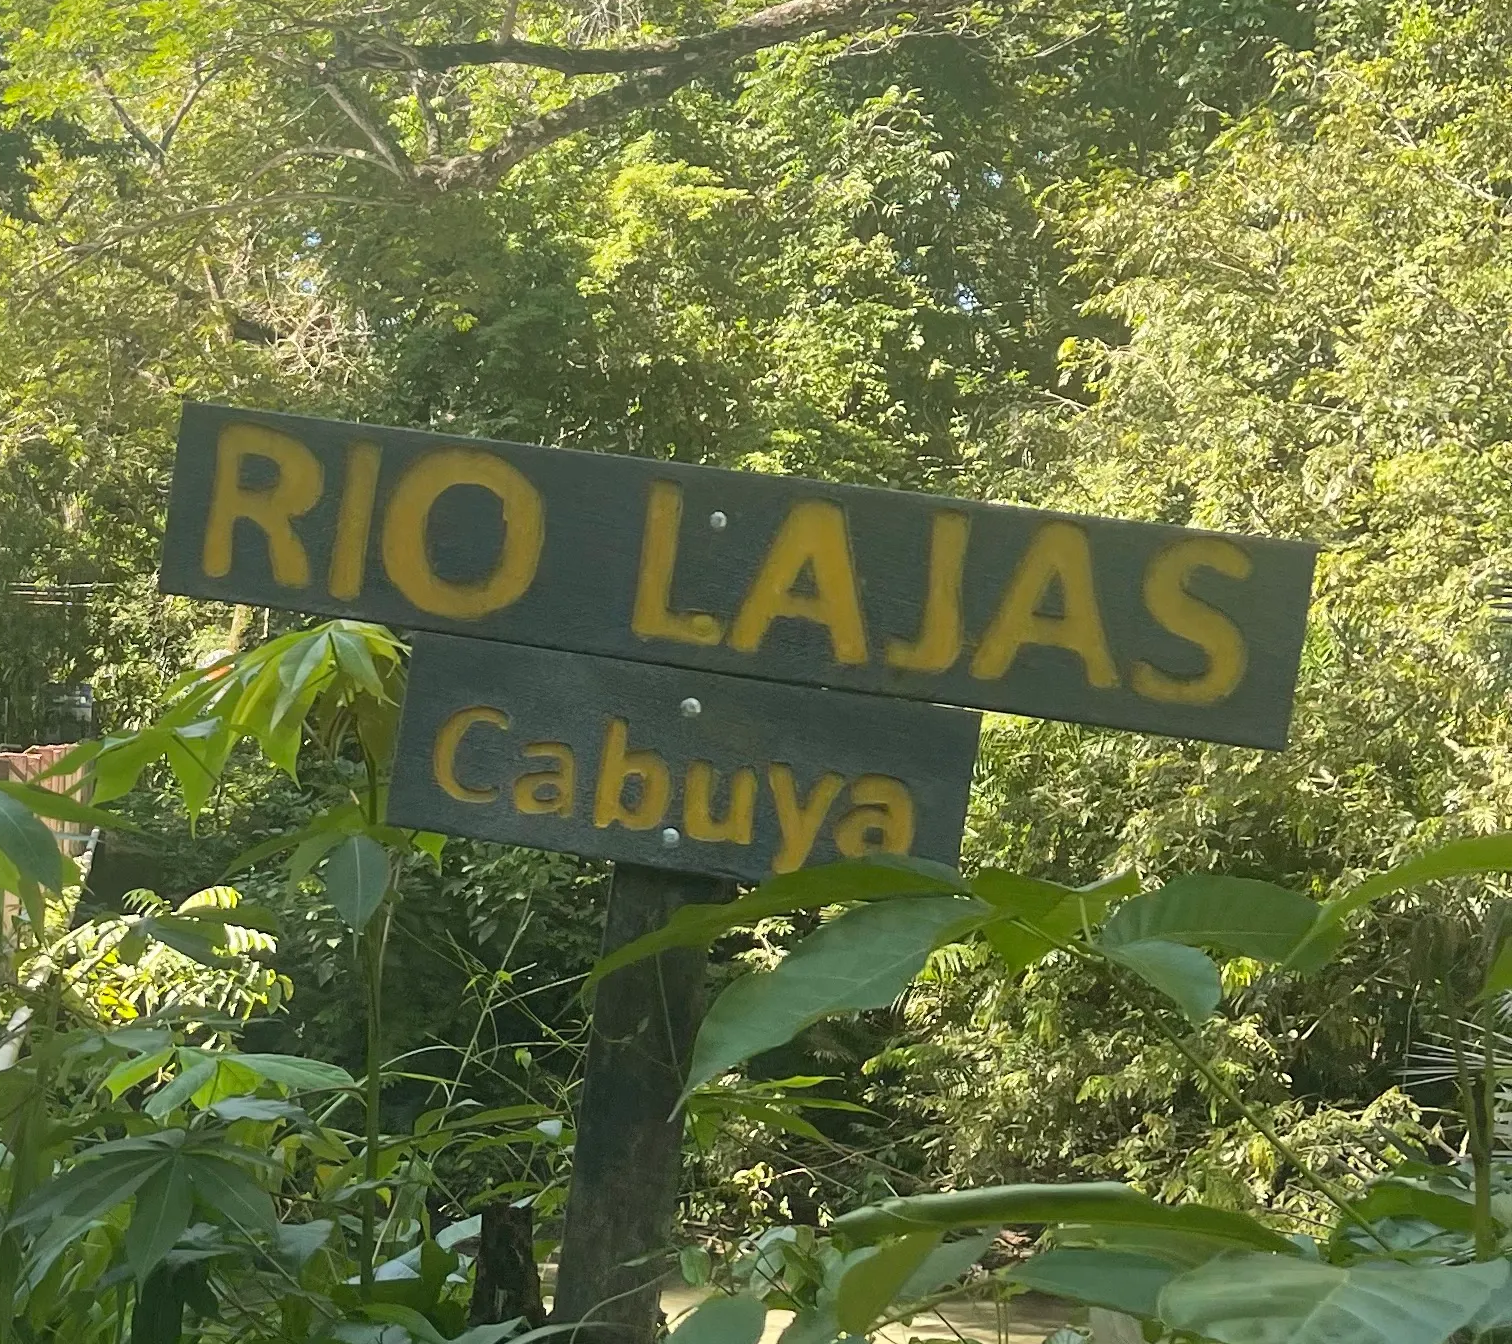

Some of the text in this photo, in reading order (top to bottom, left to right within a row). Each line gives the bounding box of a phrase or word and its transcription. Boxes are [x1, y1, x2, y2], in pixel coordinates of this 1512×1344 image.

[202, 422, 1254, 705] RIO LAJAS
[432, 705, 915, 875] Cabuya
